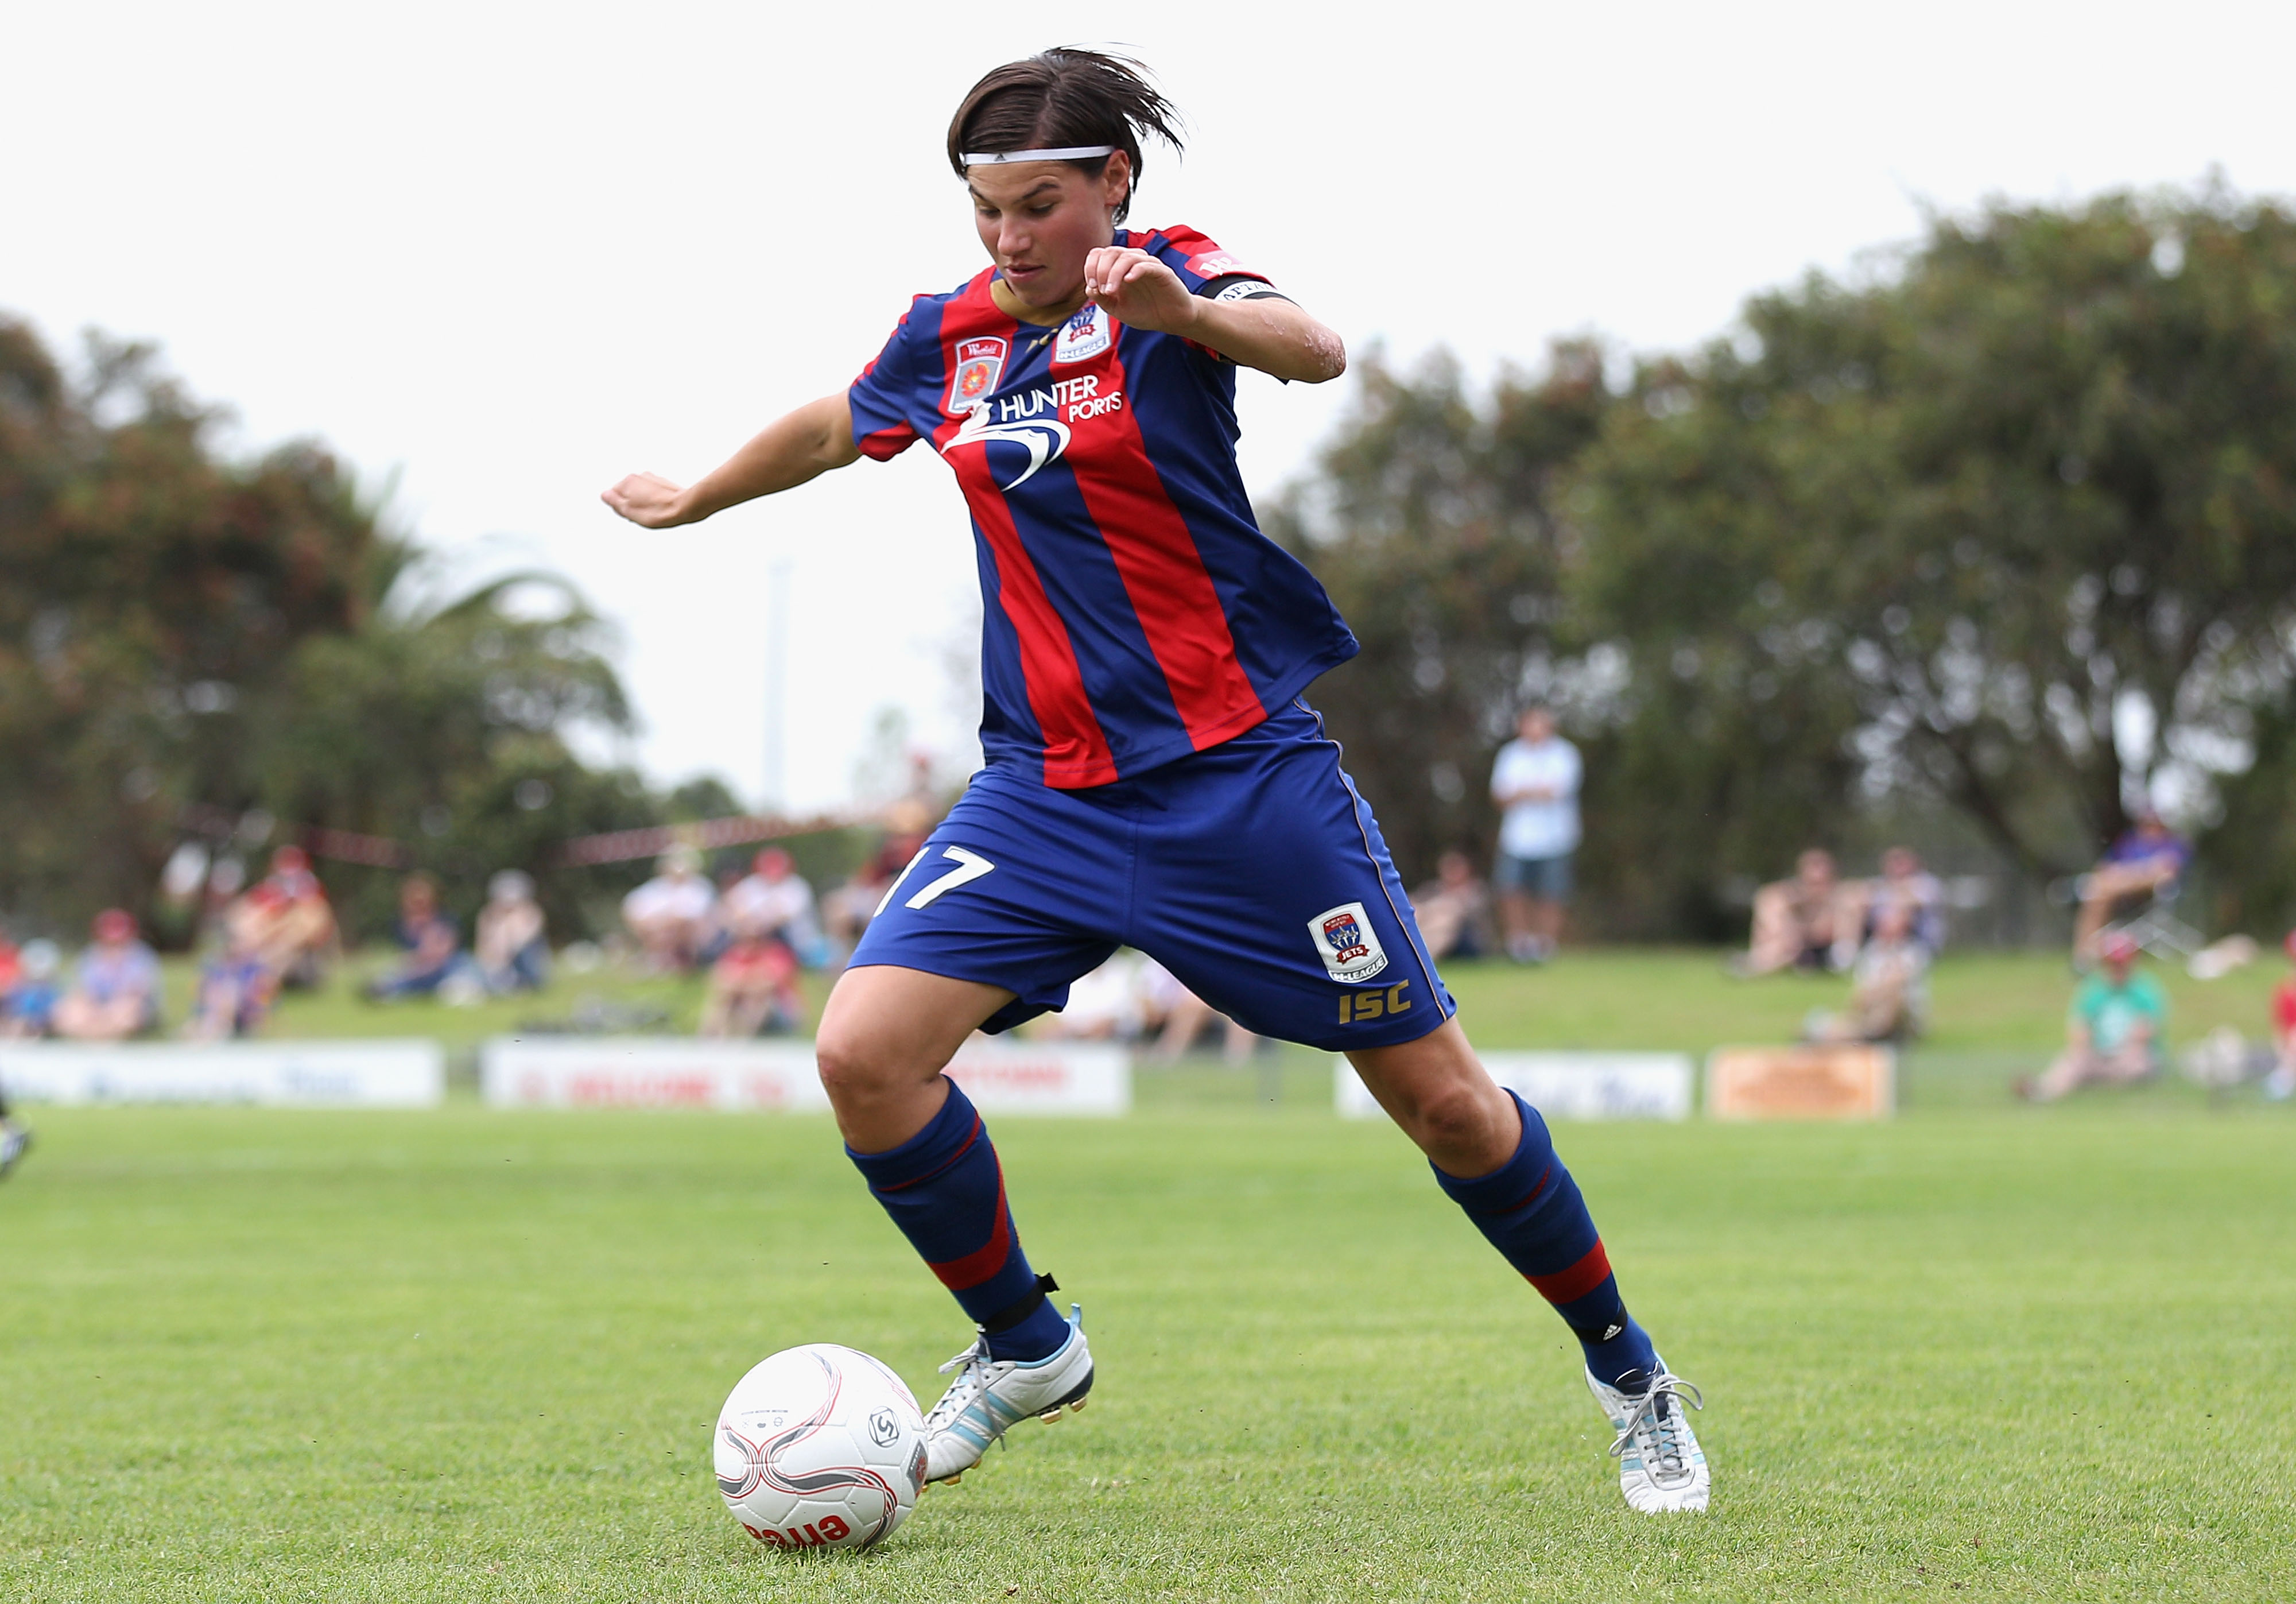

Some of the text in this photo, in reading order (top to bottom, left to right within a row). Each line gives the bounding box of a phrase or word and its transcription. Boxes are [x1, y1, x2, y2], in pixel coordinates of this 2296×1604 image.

[1000, 375, 1099, 422] HUNTER
[1069, 391, 1122, 423] PORTS
[1333, 957, 1385, 981] W-LEAGUE
[1341, 947, 1364, 960] JETS
[1339, 979, 1411, 1024] ISC
